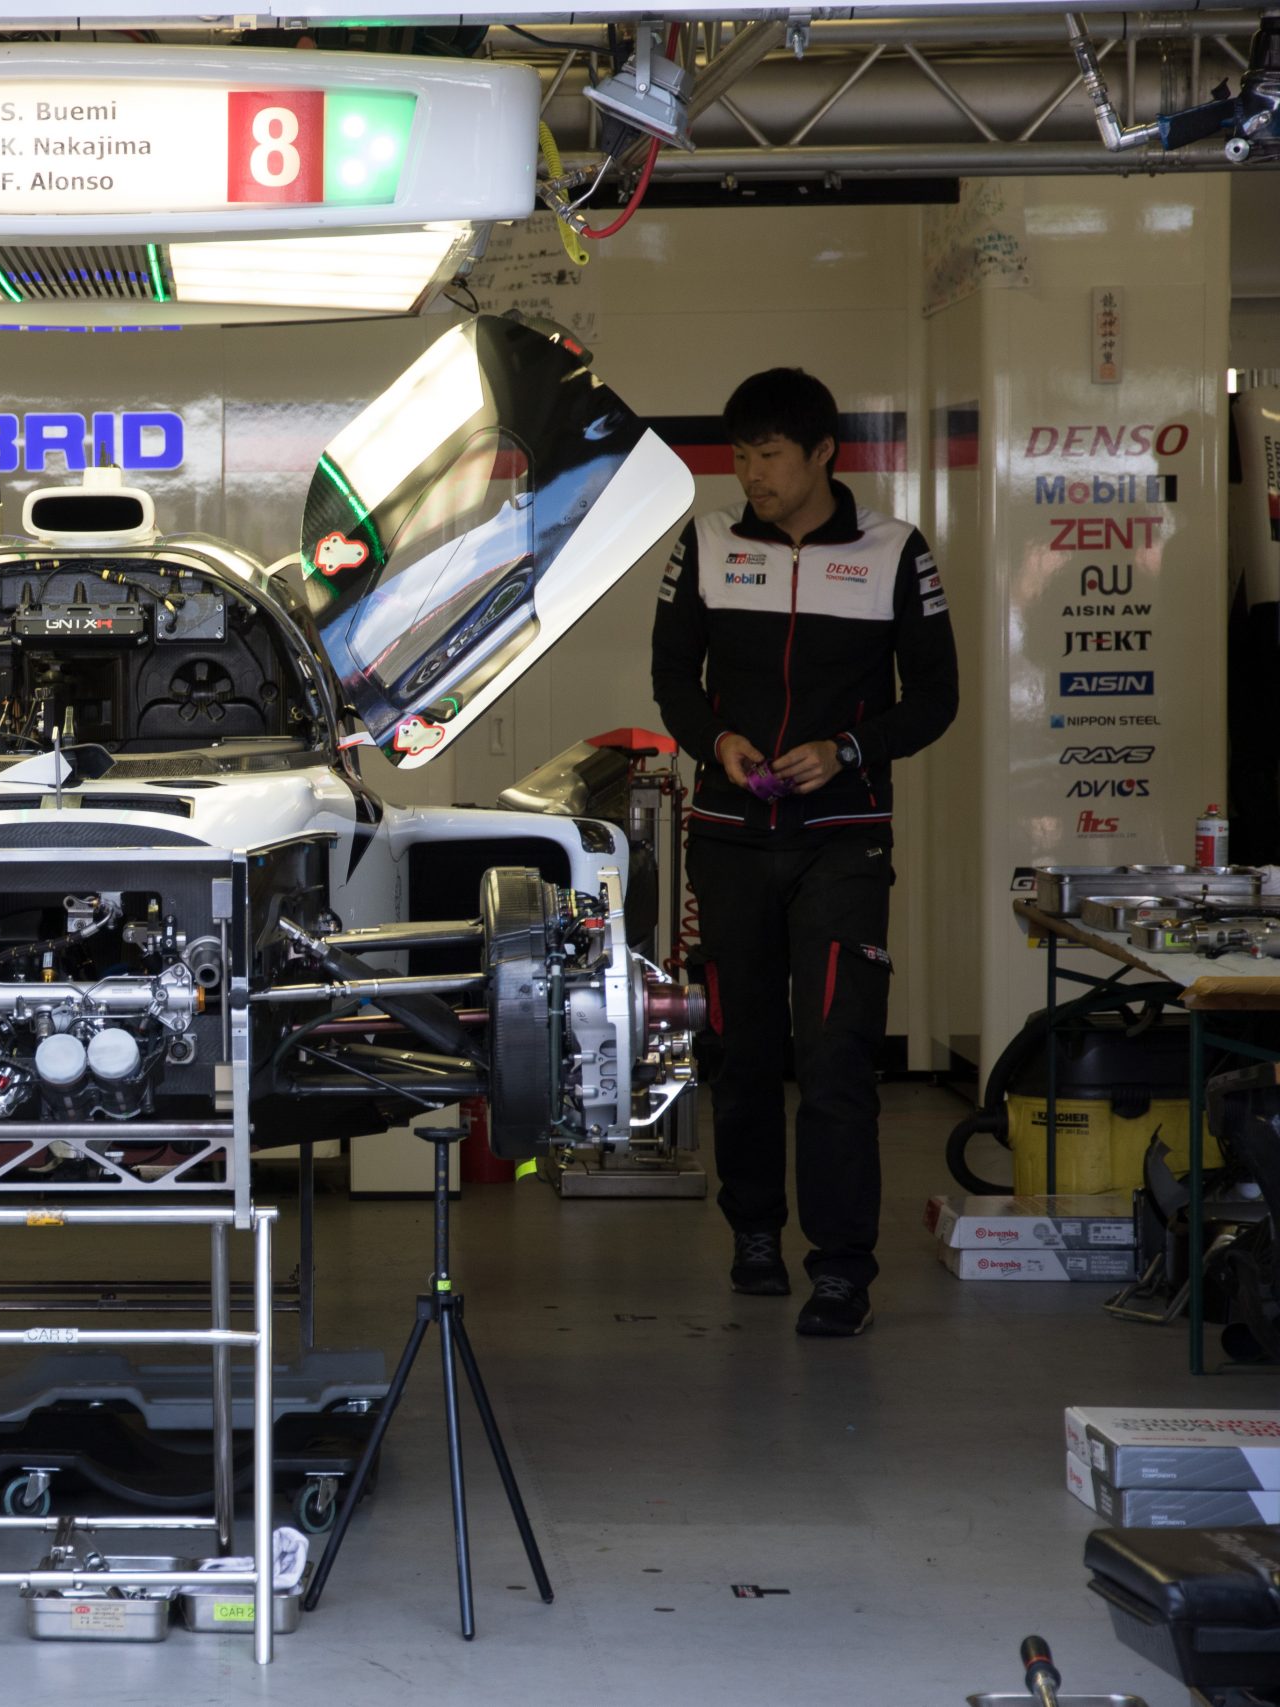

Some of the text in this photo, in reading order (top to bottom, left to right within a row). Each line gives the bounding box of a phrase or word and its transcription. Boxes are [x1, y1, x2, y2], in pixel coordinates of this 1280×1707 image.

[0, 100, 117, 122] S. Buemi
[0, 135, 152, 160] K. Nakajima
[249, 106, 301, 187] 8
[0, 171, 115, 191] F. Alonso
[1023, 423, 1190, 459] DENSO
[1034, 474, 1137, 505] Mobil
[1049, 516, 1164, 551] ZENT
[725, 572, 755, 584] Mobil
[825, 562, 869, 577] DENSO
[1061, 603, 1153, 617] AISIN AW
[1061, 629, 1153, 658] JTEKT
[1066, 674, 1148, 693] AISIN
[1066, 715, 1162, 727] NIPPON STEEL
[1059, 745, 1155, 765] RAYS
[1065, 778, 1151, 798] ADVICS
[1037, 1111, 1089, 1122] KCHER
[987, 1228, 1019, 1239] brembo
[990, 1259, 1022, 1269] brembo
[27, 1328, 74, 1341] CAR 5
[219, 1607, 255, 1618] CAR 2
